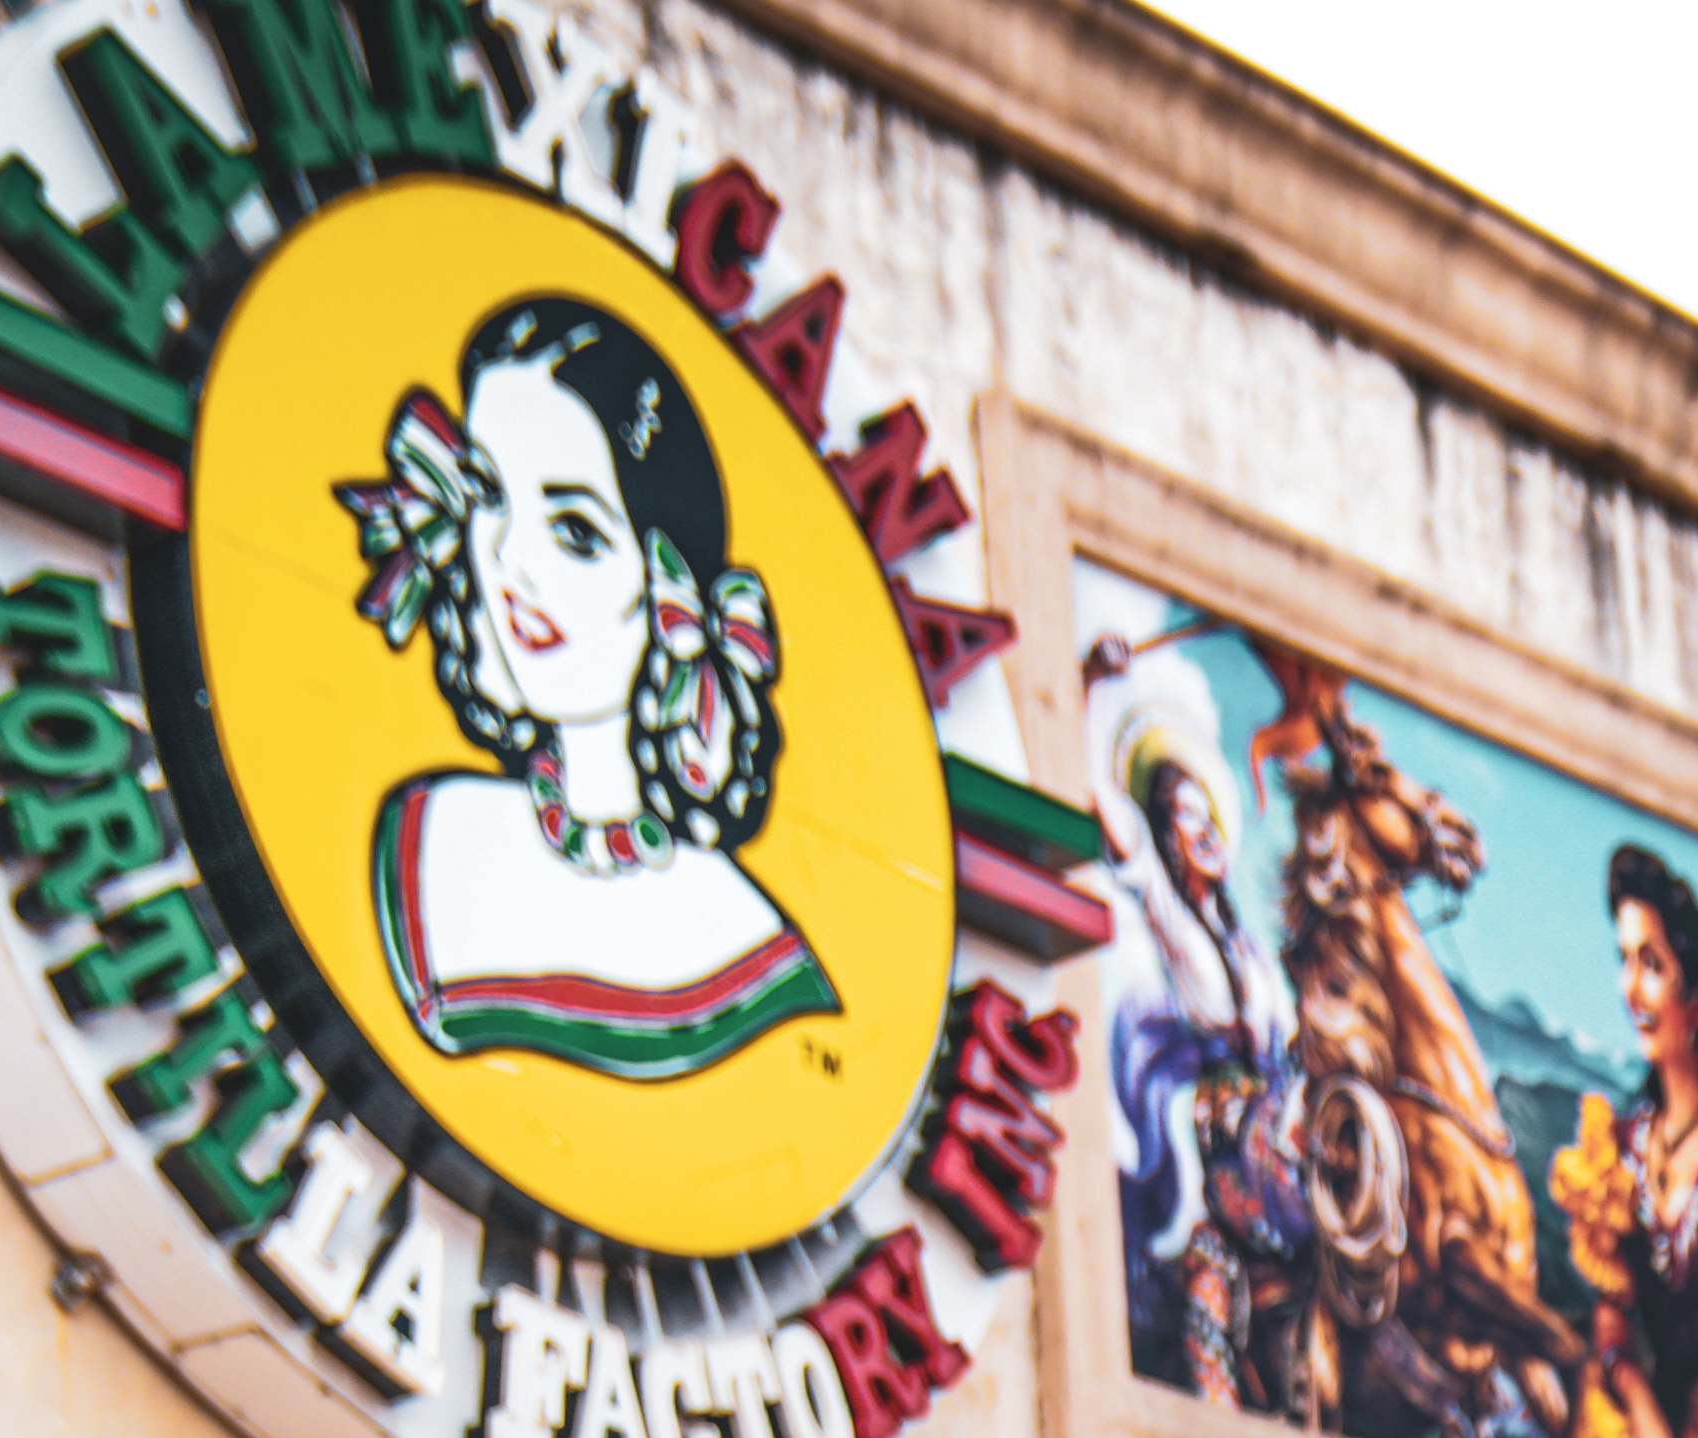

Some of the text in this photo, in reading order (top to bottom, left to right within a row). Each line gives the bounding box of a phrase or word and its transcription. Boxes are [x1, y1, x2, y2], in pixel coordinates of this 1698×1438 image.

[227, 0, 1018, 708] MEXICANA
[800, 1040, 843, 1078] TM
[912, 978, 1081, 1272] INC
